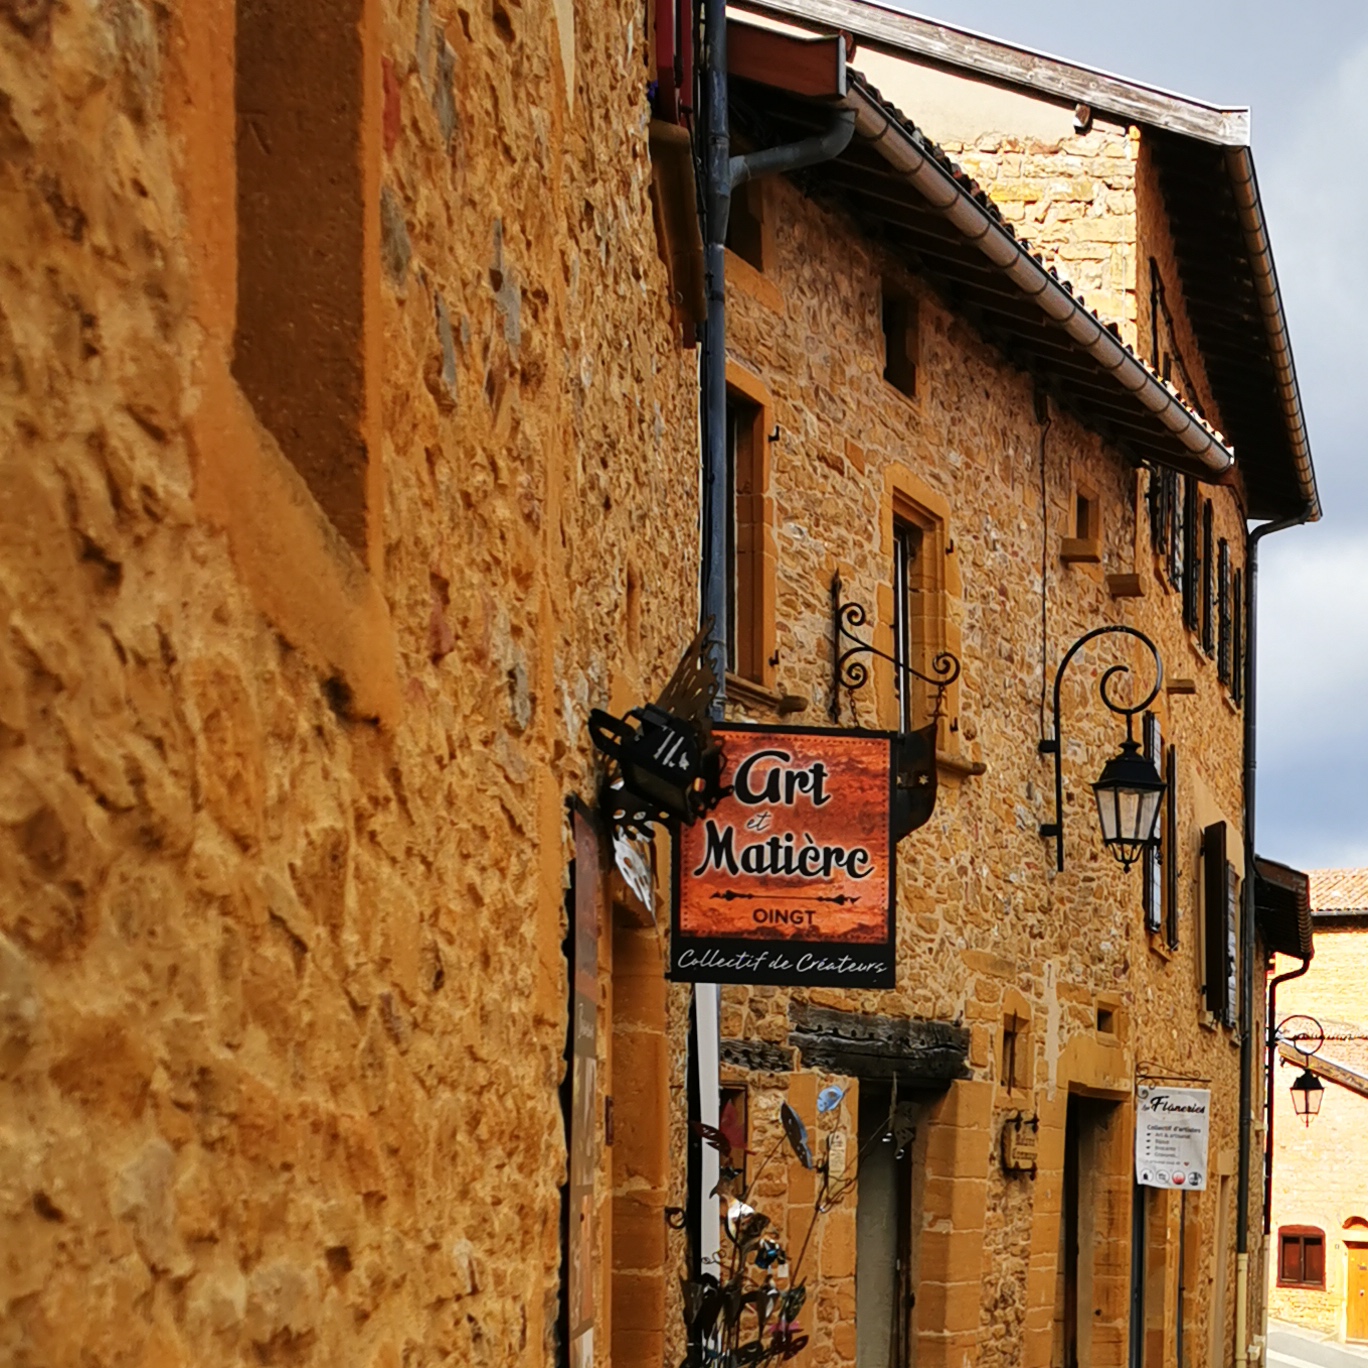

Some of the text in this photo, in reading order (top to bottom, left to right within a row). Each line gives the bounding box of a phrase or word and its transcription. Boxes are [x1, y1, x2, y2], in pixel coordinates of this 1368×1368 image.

[735, 750, 831, 806] Art
[747, 811, 771, 831] et
[693, 819, 874, 879] Matière
[753, 908, 816, 925] OINGT
[677, 949, 888, 974] Collectif de Créateurs
